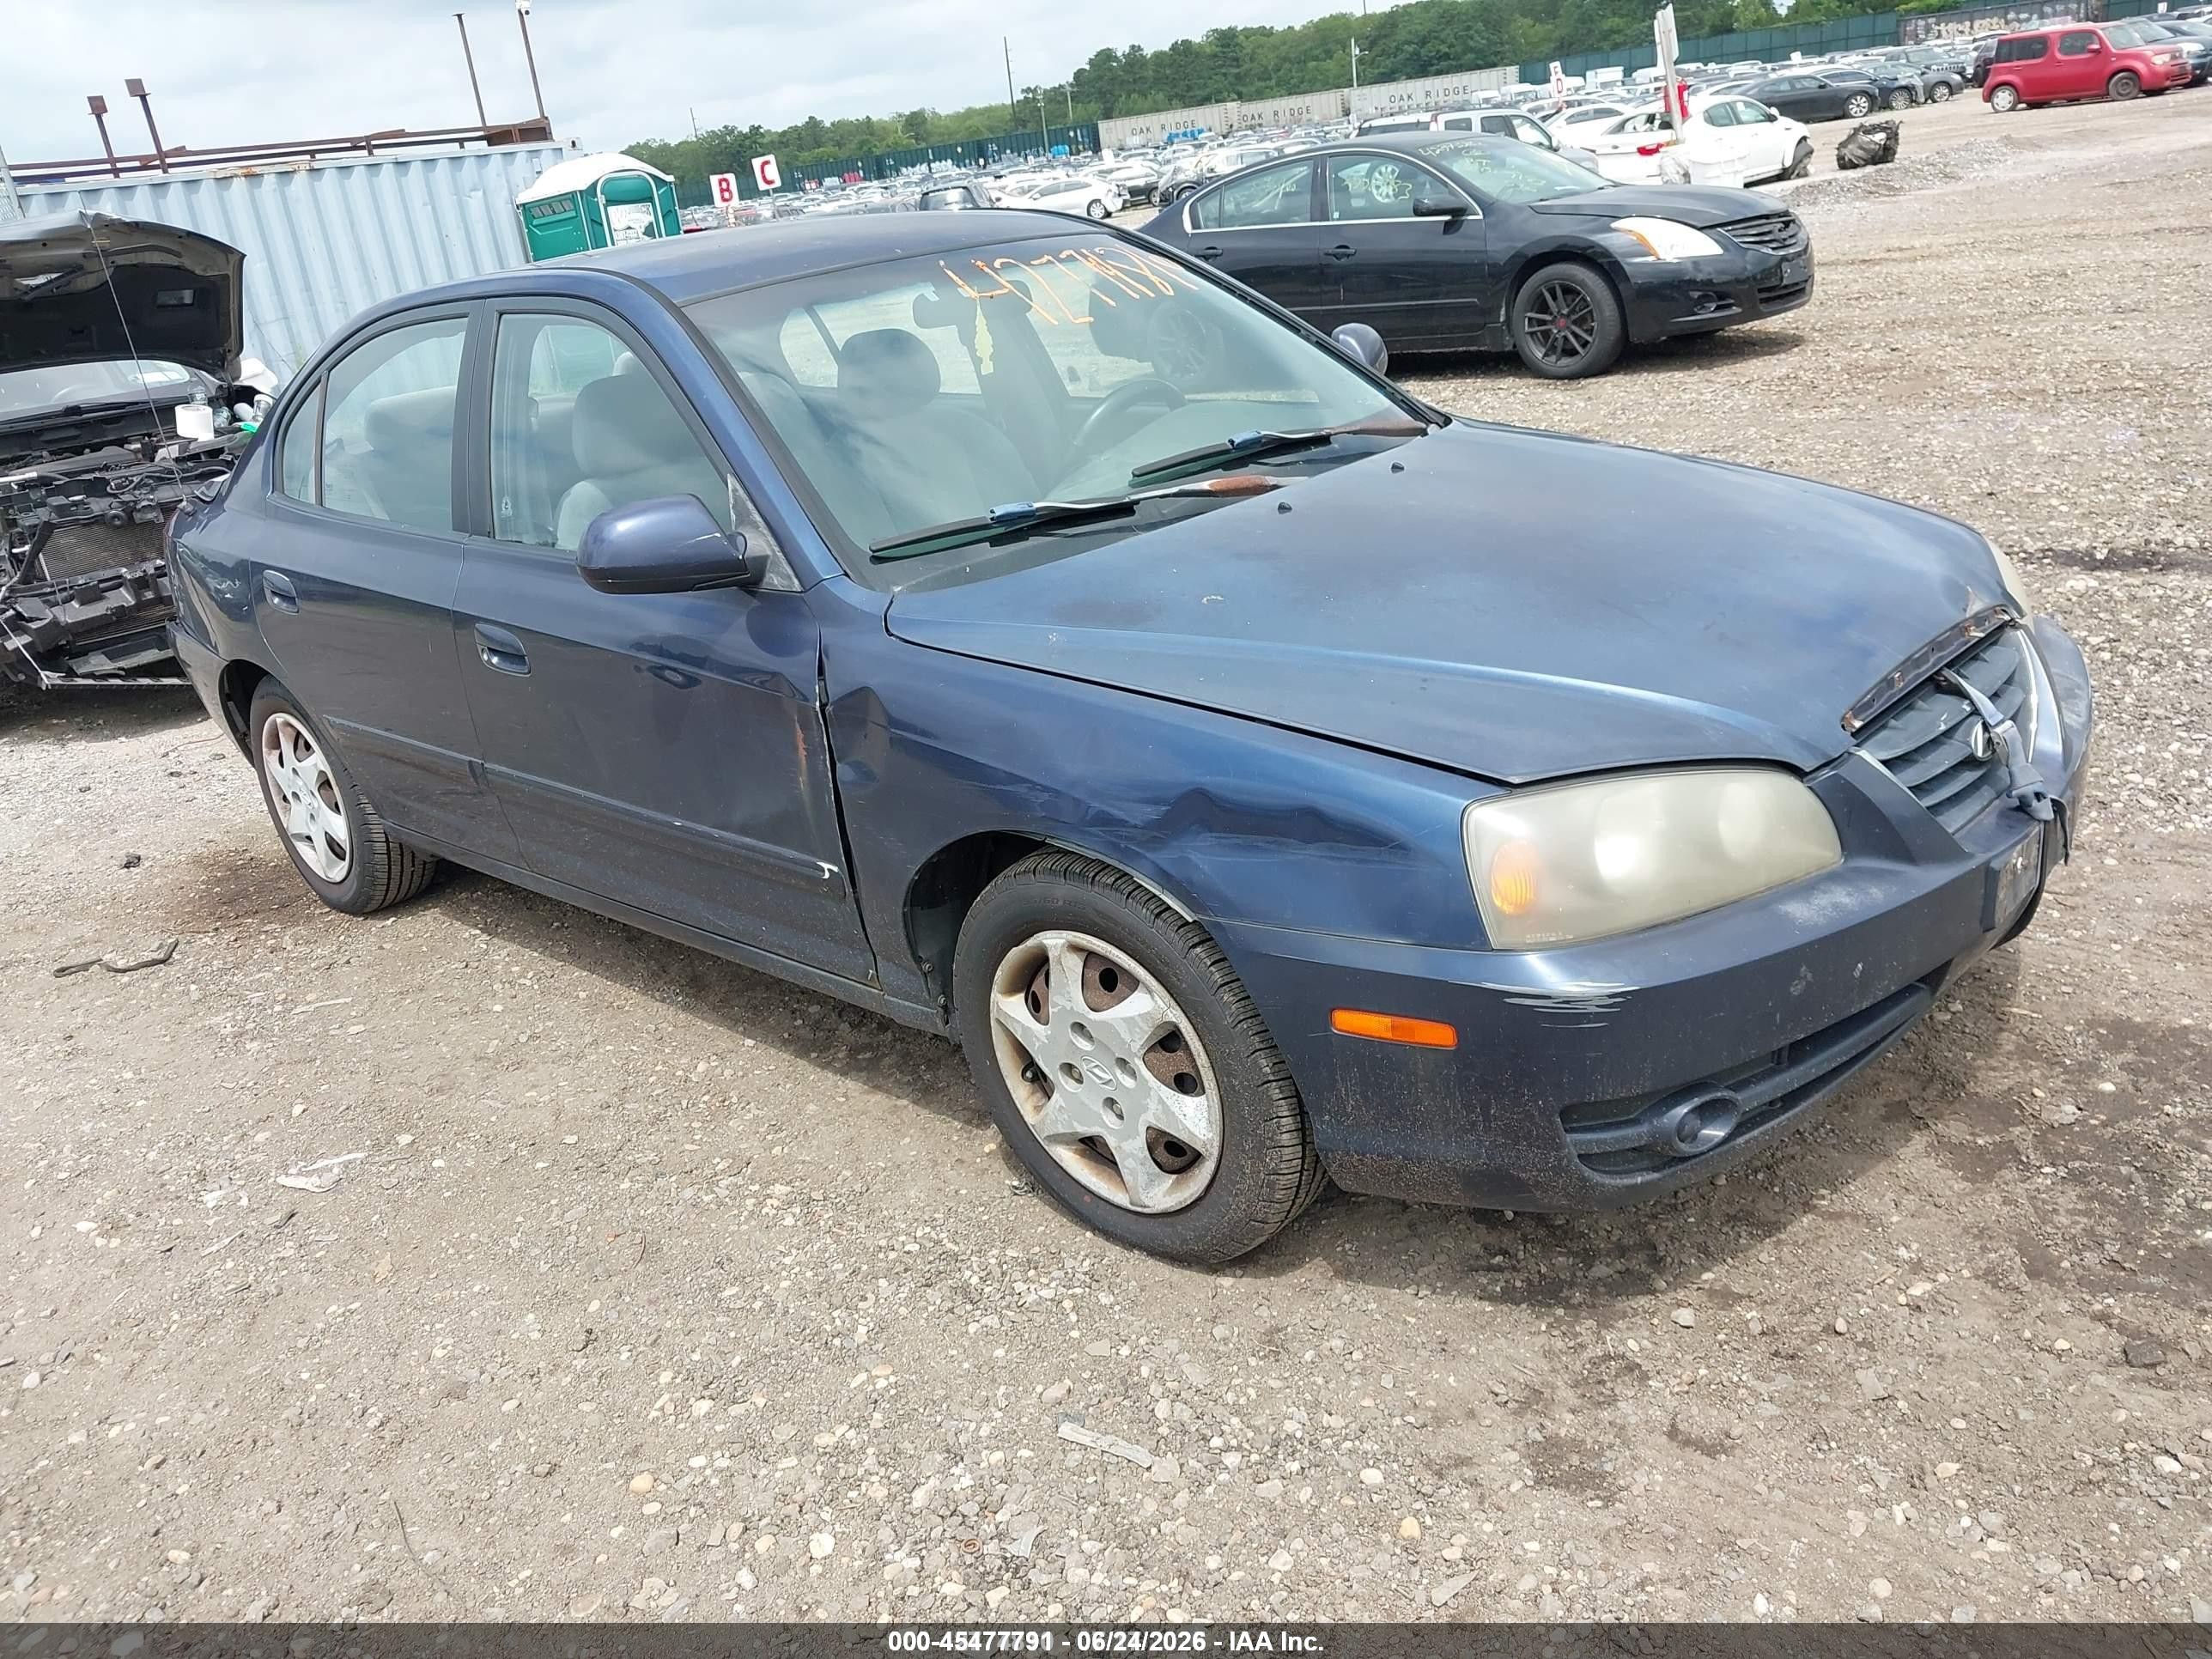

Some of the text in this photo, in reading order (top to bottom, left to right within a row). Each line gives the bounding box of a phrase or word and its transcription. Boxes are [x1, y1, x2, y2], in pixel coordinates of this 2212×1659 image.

[1389, 85, 1469, 104] OAK RIDGE
[1243, 106, 1311, 123] OAK RIDGE
[1131, 118, 1197, 136] OAK RIDGE
[760, 160, 775, 185] C
[718, 178, 733, 202] B
